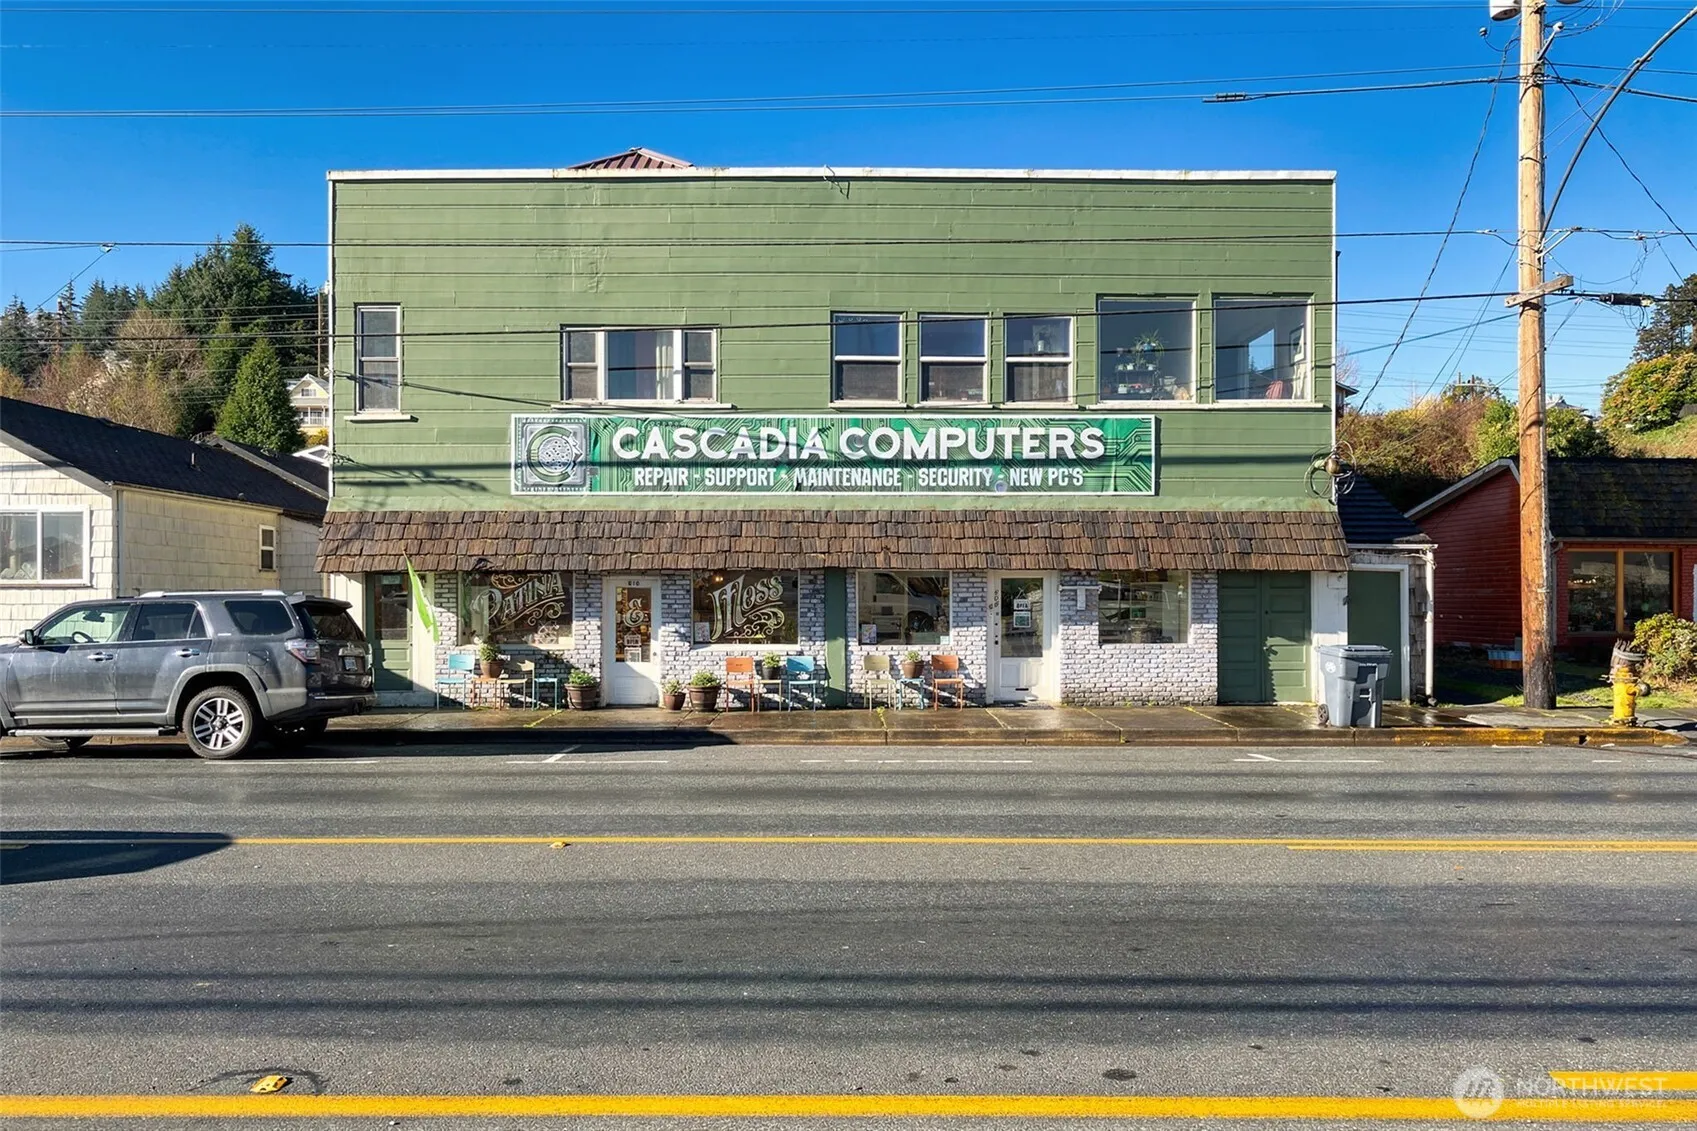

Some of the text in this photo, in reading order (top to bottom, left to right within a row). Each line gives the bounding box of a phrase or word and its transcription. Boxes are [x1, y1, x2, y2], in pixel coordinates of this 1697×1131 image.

[612, 426, 1105, 460] CASCADIA COMPUTERS
[634, 467, 689, 486] REPAIR
[704, 467, 777, 486] SUPPORT
[793, 467, 902, 486] MAINTENANCE
[918, 467, 993, 486] SECURITY
[1009, 467, 1044, 486] NEW
[1048, 467, 1084, 486] PC'S
